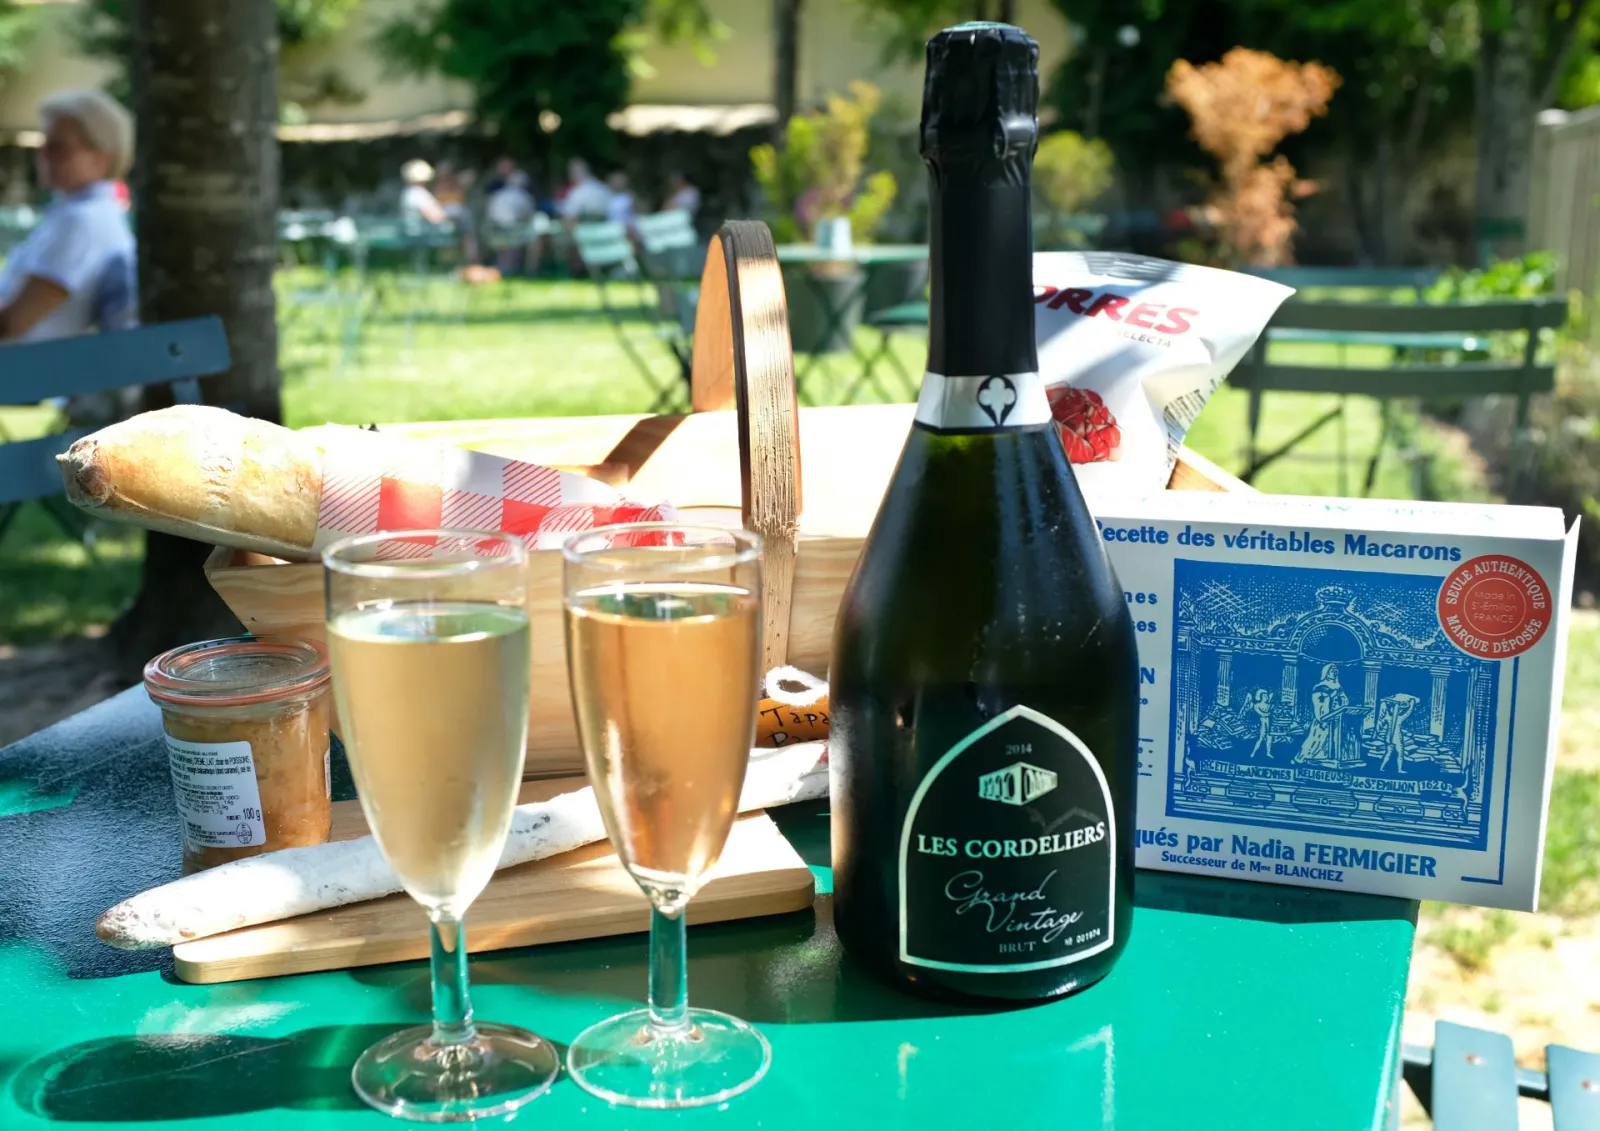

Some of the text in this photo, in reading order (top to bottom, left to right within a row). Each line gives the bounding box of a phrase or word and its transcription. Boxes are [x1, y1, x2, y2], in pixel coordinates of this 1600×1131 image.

[1177, 525, 1215, 547] des
[1224, 528, 1335, 555] véritables
[1344, 534, 1461, 561] Macarons
[1445, 561, 1546, 609] SEULE AUTHENTIQUE
[1446, 614, 1543, 653] MARQUE DÉPOSÉE
[1473, 613, 1515, 623] FRANCE
[1005, 743, 1032, 755] 2014
[243, 807, 261, 821] 100 g
[917, 821, 1105, 858] LES CORDELIERS
[1187, 834, 1223, 854] par
[1232, 834, 1295, 861] Nadia
[1304, 842, 1437, 878] FERMIGIER
[1161, 850, 1343, 882] Successeur de Mme BLANCHEZ
[945, 870, 1084, 943] Grand Vintage
[999, 941, 1036, 953] BRUT
